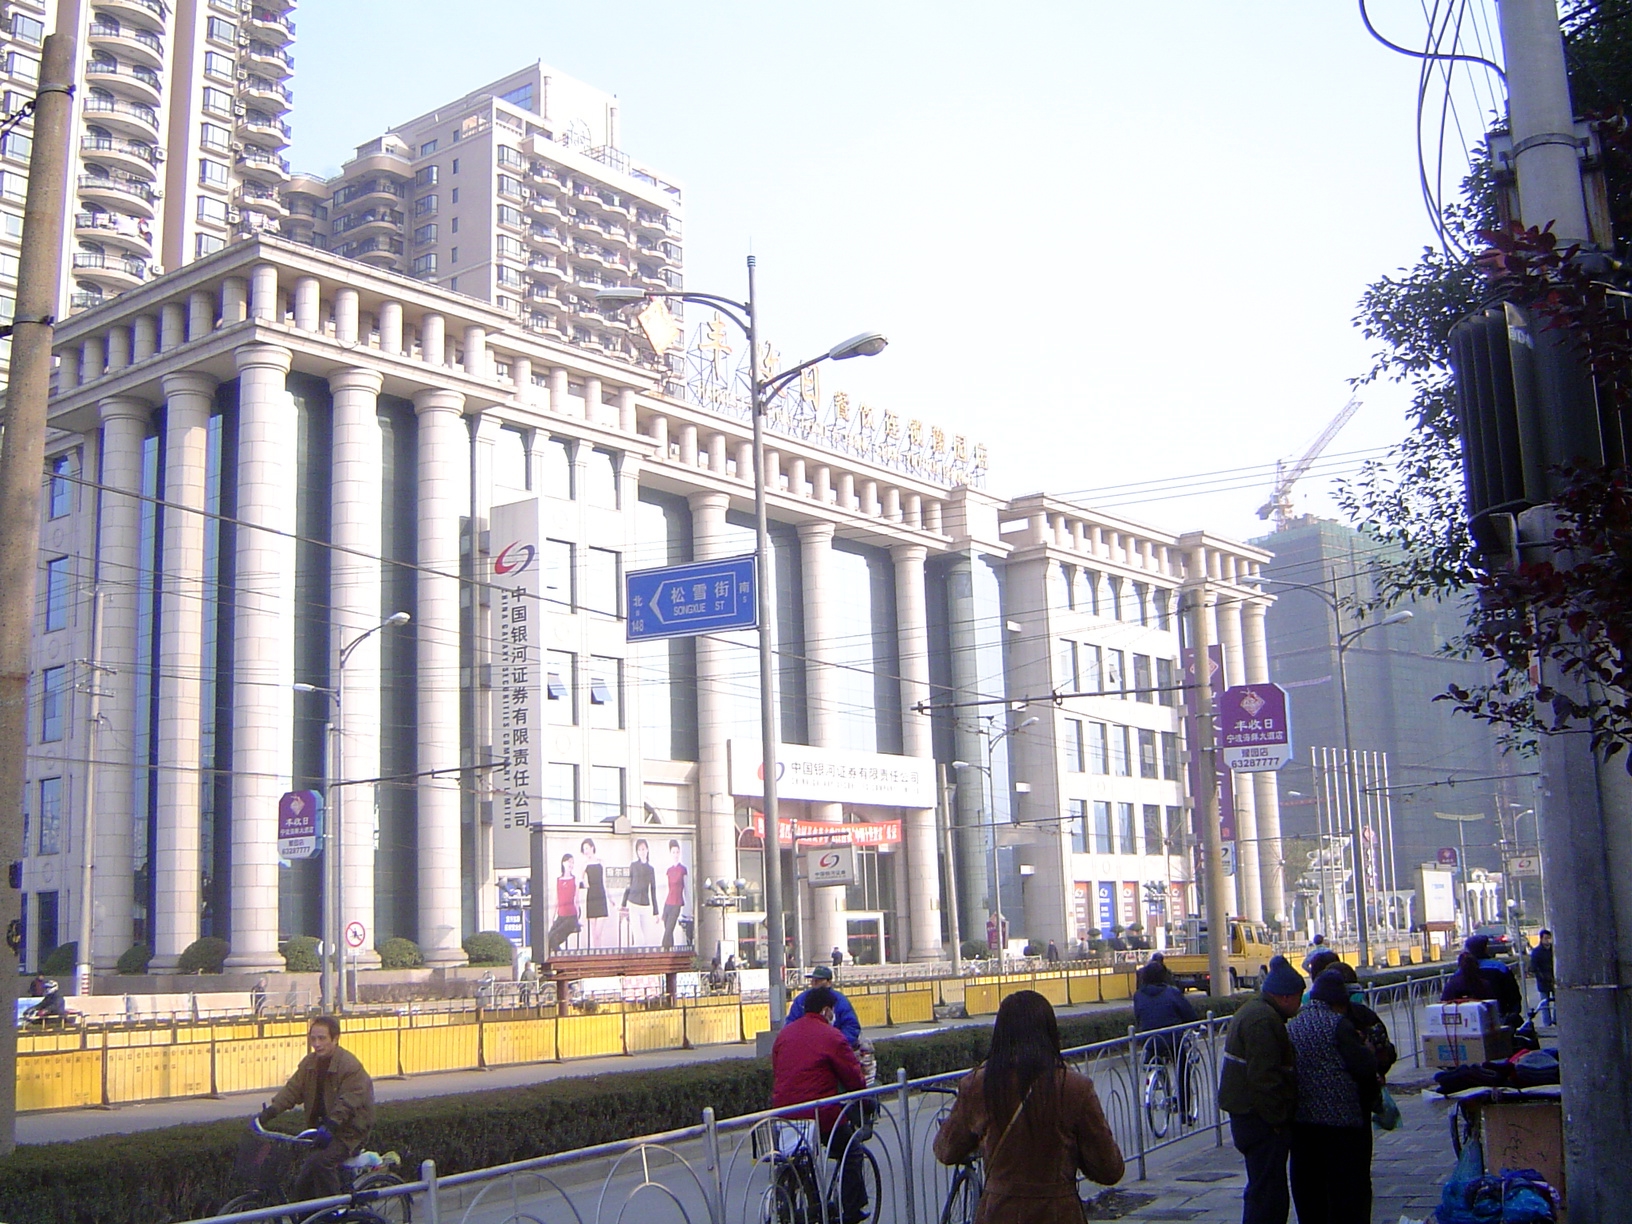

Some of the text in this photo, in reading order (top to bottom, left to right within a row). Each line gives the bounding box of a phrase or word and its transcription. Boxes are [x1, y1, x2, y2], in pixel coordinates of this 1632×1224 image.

[671, 580, 729, 604] 松雪街
[739, 581, 750, 594] 南
[632, 595, 643, 607] 北
[715, 600, 725, 611] ST
[511, 586, 530, 828] 中国银河证券有限责任公司
[1234, 718, 1274, 731] 丰收日
[1231, 757, 1280, 769] 63287777
